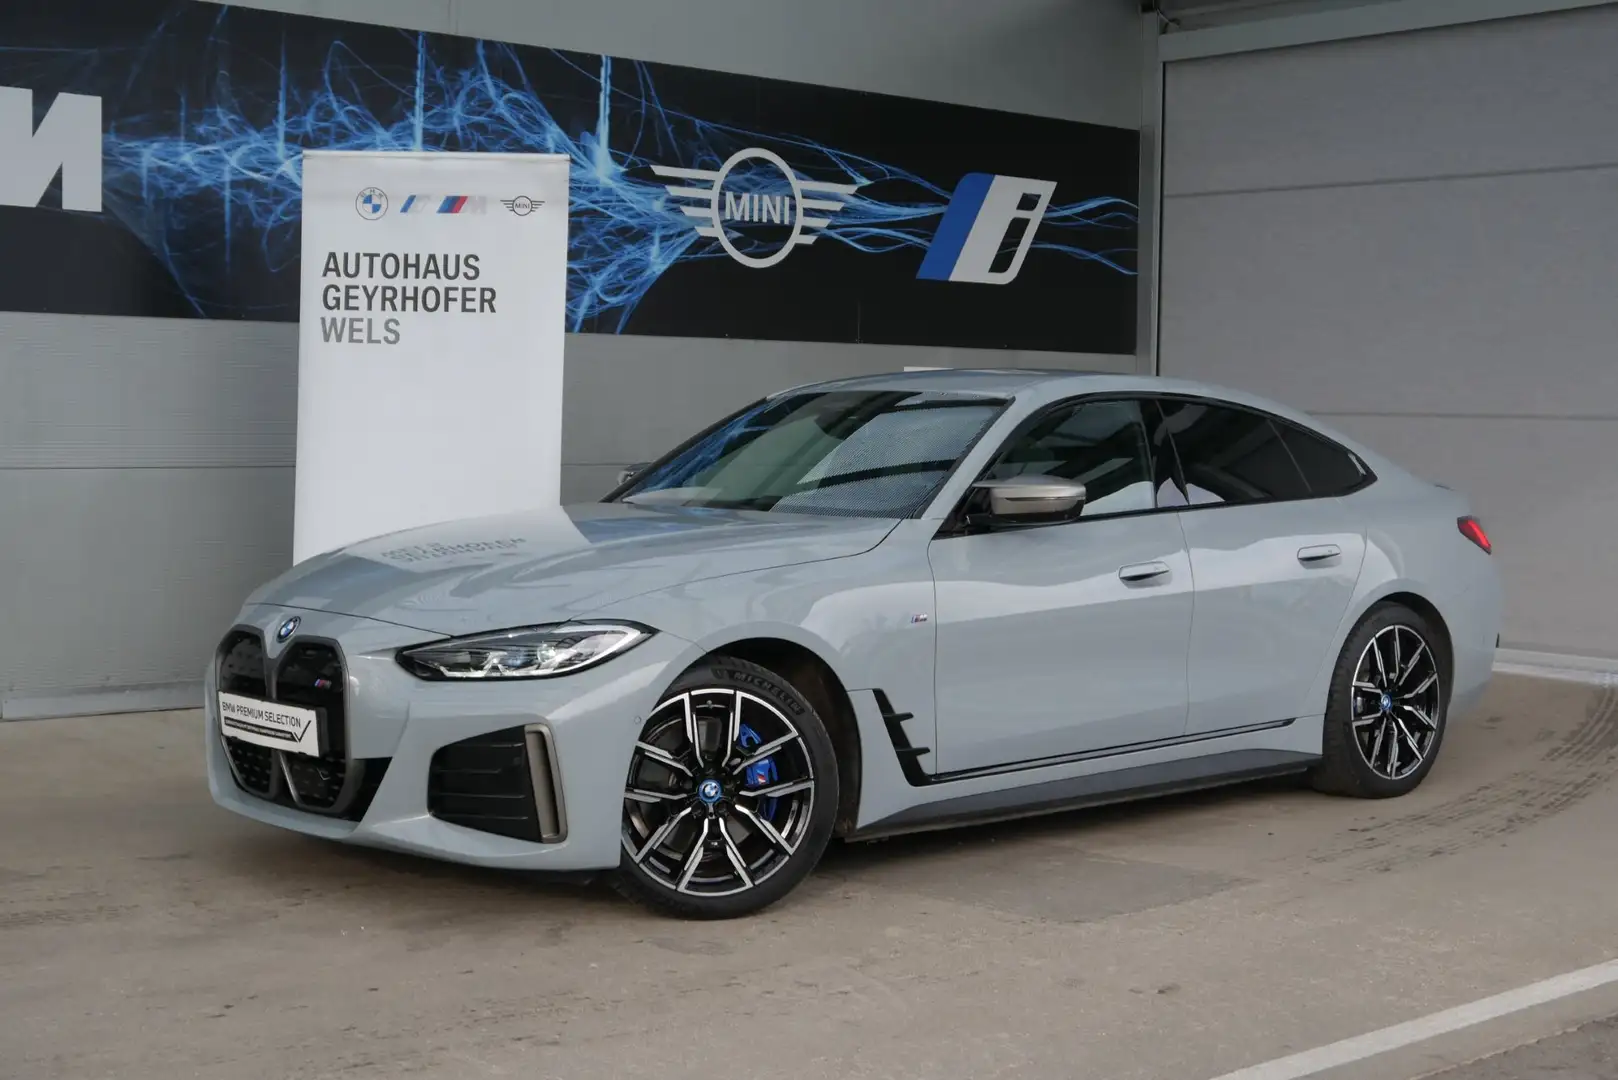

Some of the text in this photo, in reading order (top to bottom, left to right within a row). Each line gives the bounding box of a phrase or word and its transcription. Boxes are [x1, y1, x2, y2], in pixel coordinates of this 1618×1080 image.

[725, 191, 790, 225] MINI
[322, 251, 480, 281] AUTOHAUS
[322, 284, 497, 313] GEYRHOFER
[320, 316, 401, 345] WELS
[222, 701, 301, 728] BMW PREMIUM SELECTION
